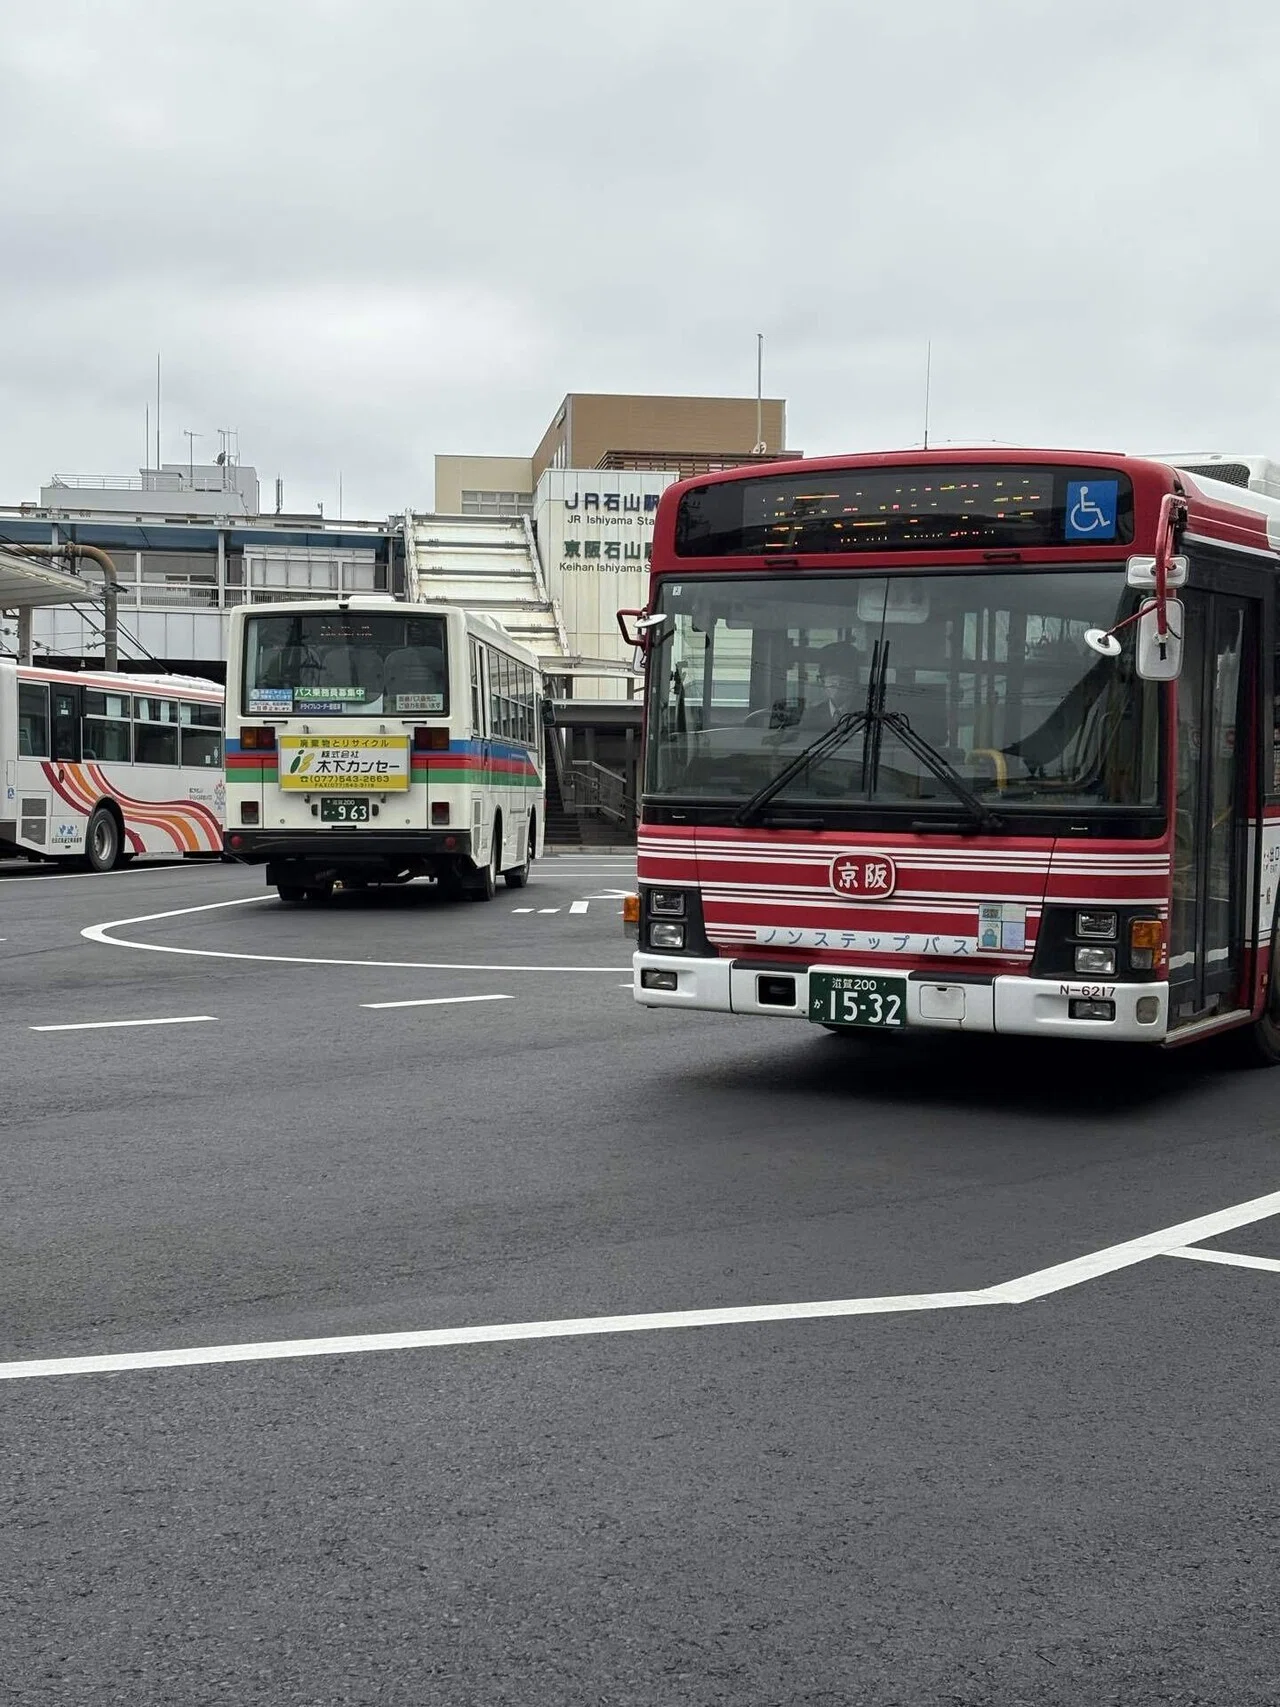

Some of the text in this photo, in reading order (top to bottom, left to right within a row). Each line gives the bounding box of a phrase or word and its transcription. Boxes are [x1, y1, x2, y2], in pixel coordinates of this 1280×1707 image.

[567, 514, 581, 524] JR
[586, 515, 633, 527] Ishiyama
[559, 562, 594, 572] Keihan
[597, 563, 642, 574] Ishiyama
[321, 750, 360, 758] 株式会社
[315, 760, 401, 773] 木下カンセー
[837, 861, 888, 889] 京阪
[763, 929, 970, 955] ノンステップバス
[1059, 984, 1116, 998] N-6217
[813, 998, 824, 1009] か
[830, 990, 901, 1025] 15-32
